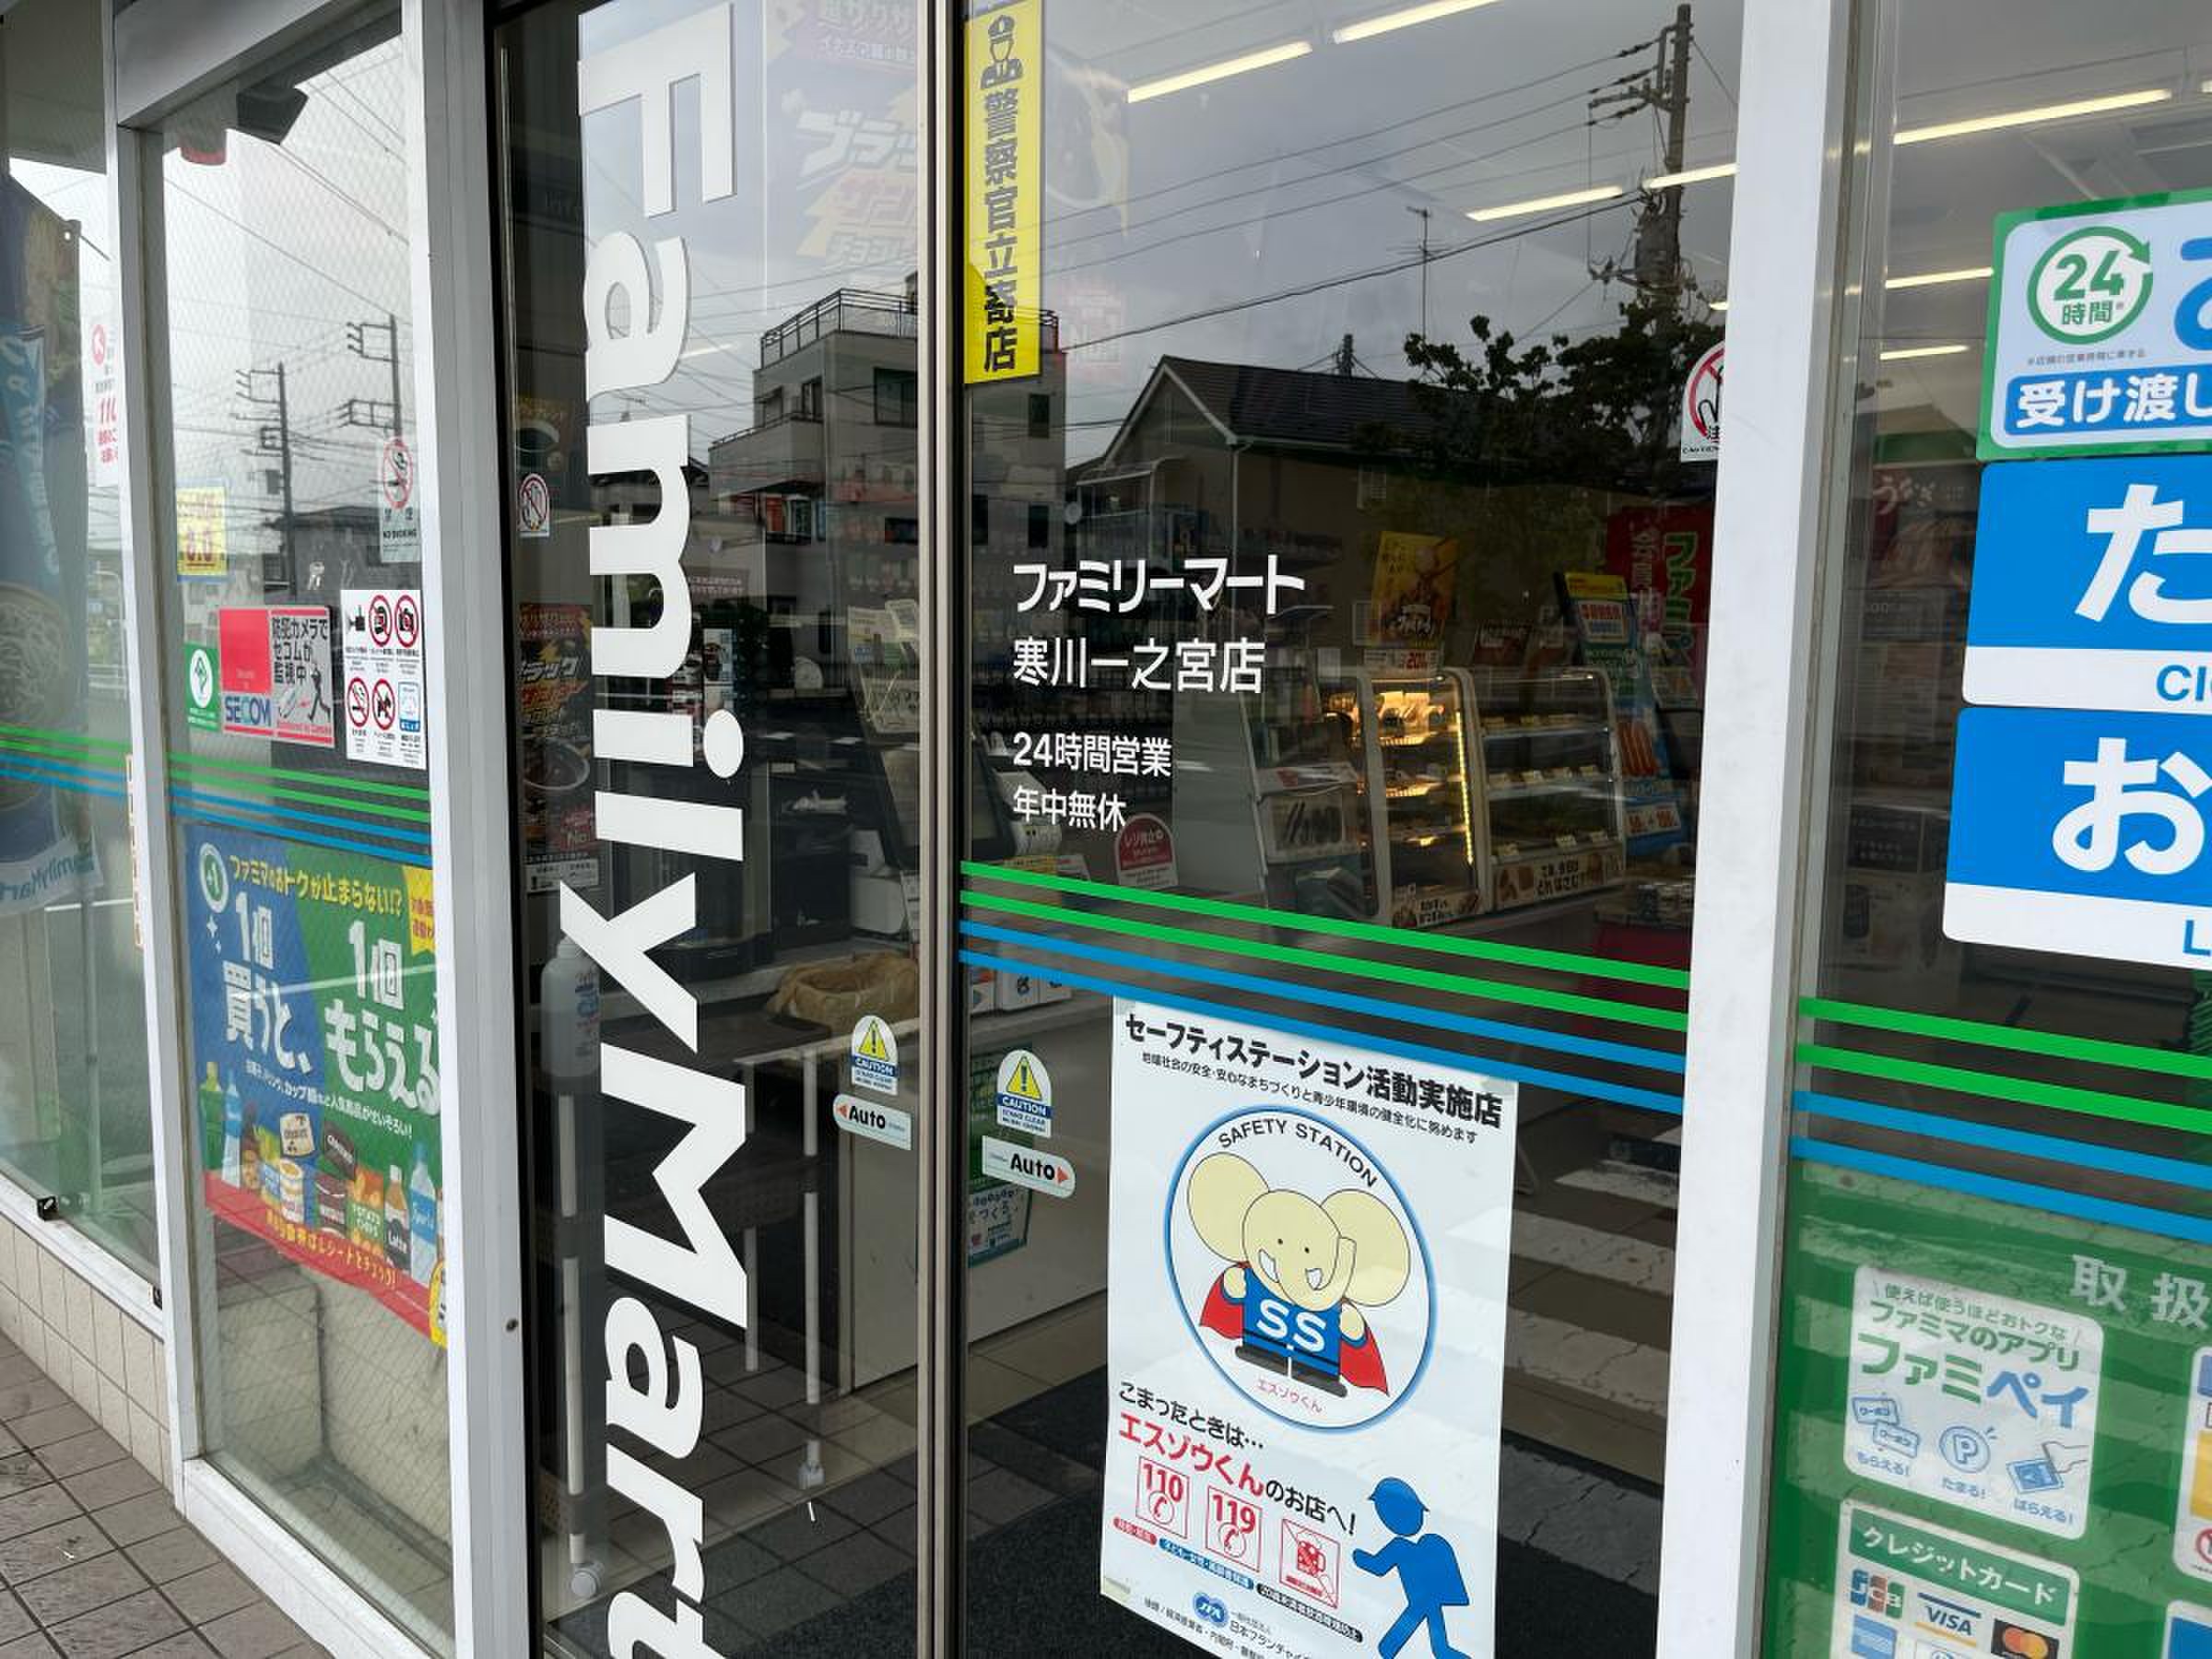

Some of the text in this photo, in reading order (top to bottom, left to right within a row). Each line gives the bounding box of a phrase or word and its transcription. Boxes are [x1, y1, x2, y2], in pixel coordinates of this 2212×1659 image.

[980, 88, 1018, 372] 警察官立寄店
[2053, 250, 2125, 302] 24
[2017, 372, 2212, 428] 受け渡し
[2075, 484, 2212, 625] た
[1013, 554, 1305, 616] ファミリーマート
[1013, 637, 1265, 694] 寒川一之宮店
[2156, 665, 2212, 702] CI
[224, 695, 272, 727] SECOM
[1013, 732, 1172, 778] 24時間営業
[559, 0, 748, 1659] FamilyMart
[1013, 785, 1126, 832] 年中無休
[2053, 737, 2212, 875] お
[235, 891, 274, 970] 1個
[2183, 919, 2211, 957] L
[348, 920, 405, 1010] 1個
[324, 998, 441, 1116] もらえる
[855, 1056, 894, 1077] CAUTION
[1125, 1013, 1503, 1129] セーフティステーション活動実施店
[848, 1105, 886, 1129] Auto
[1002, 1095, 1048, 1117] CAUTION
[1010, 1153, 1055, 1181] Auto
[1217, 1118, 1379, 1189] SAFETY STATION
[1256, 1299, 1327, 1353] SS
[1869, 1300, 2079, 1371] ファミマのアプリ
[1857, 1333, 2089, 1430] ファミペイ
[1119, 1411, 1357, 1537] エスゾウくんのお店へ!
[1952, 1433, 1978, 1465] P
[1142, 1463, 1184, 1503] 110
[1212, 1493, 1256, 1535] 119
[1862, 1525, 2058, 1606] クレジットカード
[1851, 1574, 1903, 1613] JCB
[1925, 1606, 1972, 1636] VISA
